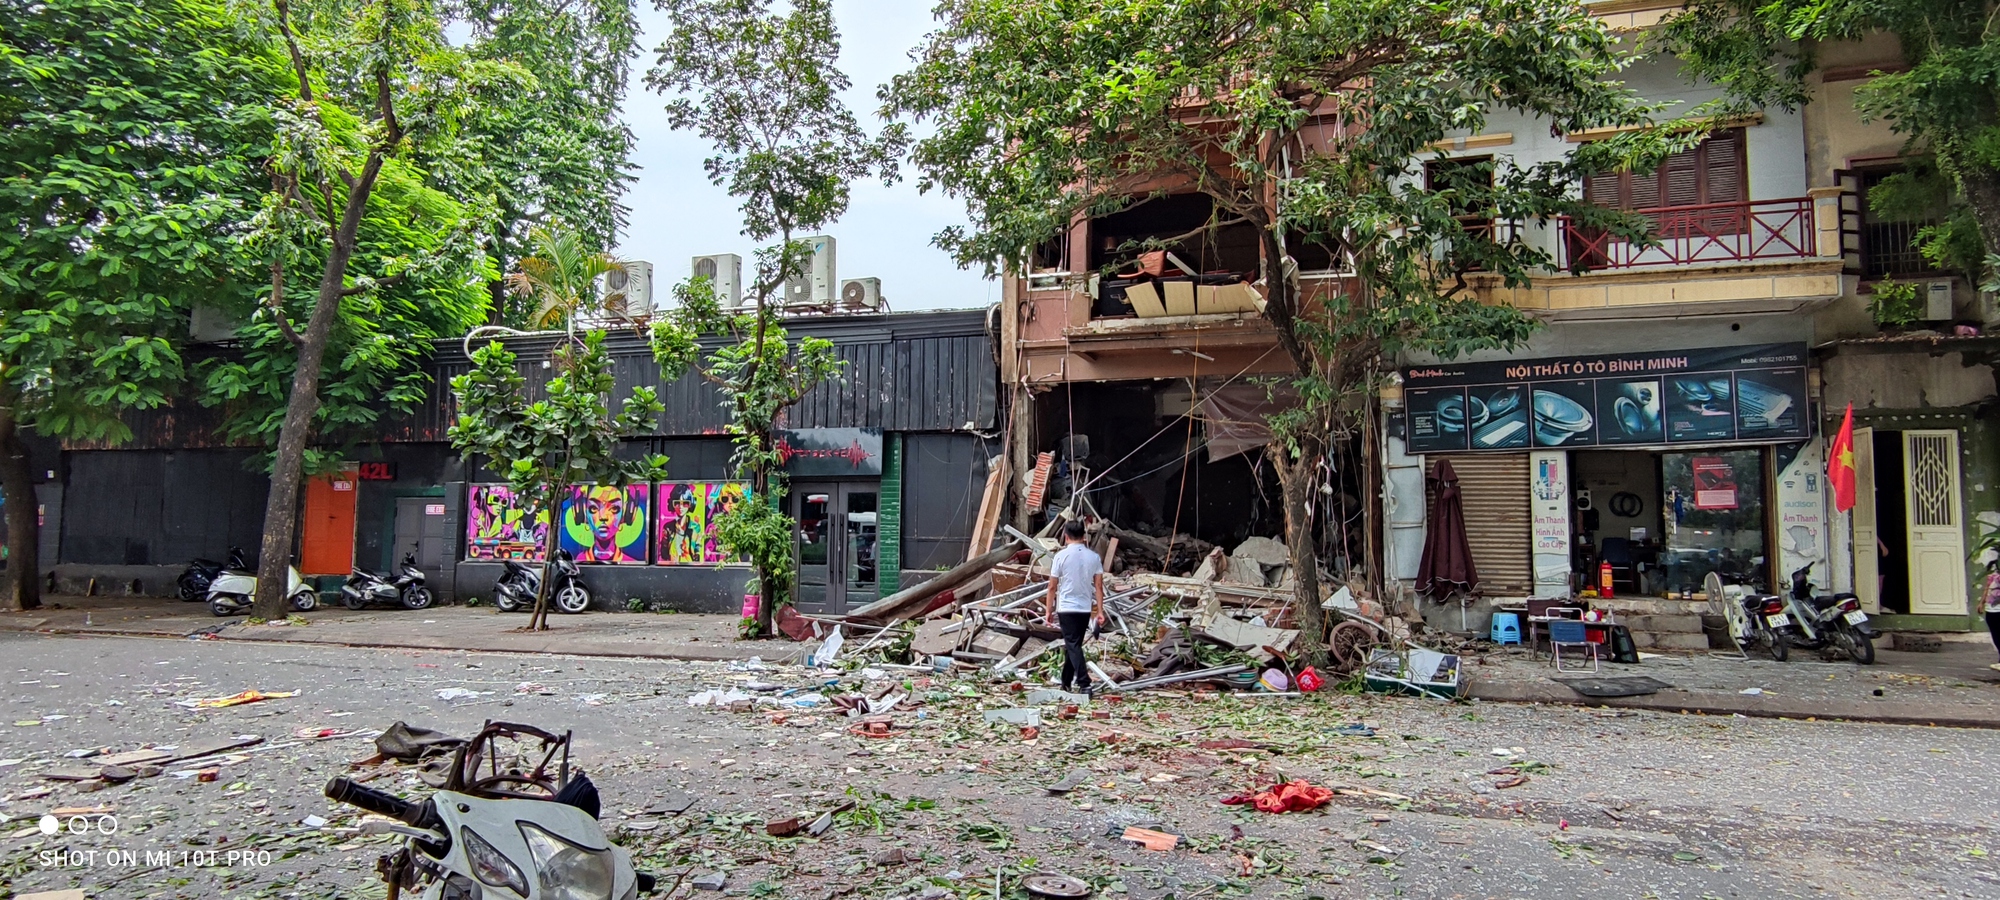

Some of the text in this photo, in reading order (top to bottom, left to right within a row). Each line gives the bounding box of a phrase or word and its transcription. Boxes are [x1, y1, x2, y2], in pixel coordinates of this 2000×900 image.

[1506, 356, 1688, 380] NỘI THẤT Ô TÔ BÌNH MINH
[360, 462, 393, 480] 42L
[1546, 516, 1565, 524] Thanh
[1796, 514, 1818, 522] Thanh
